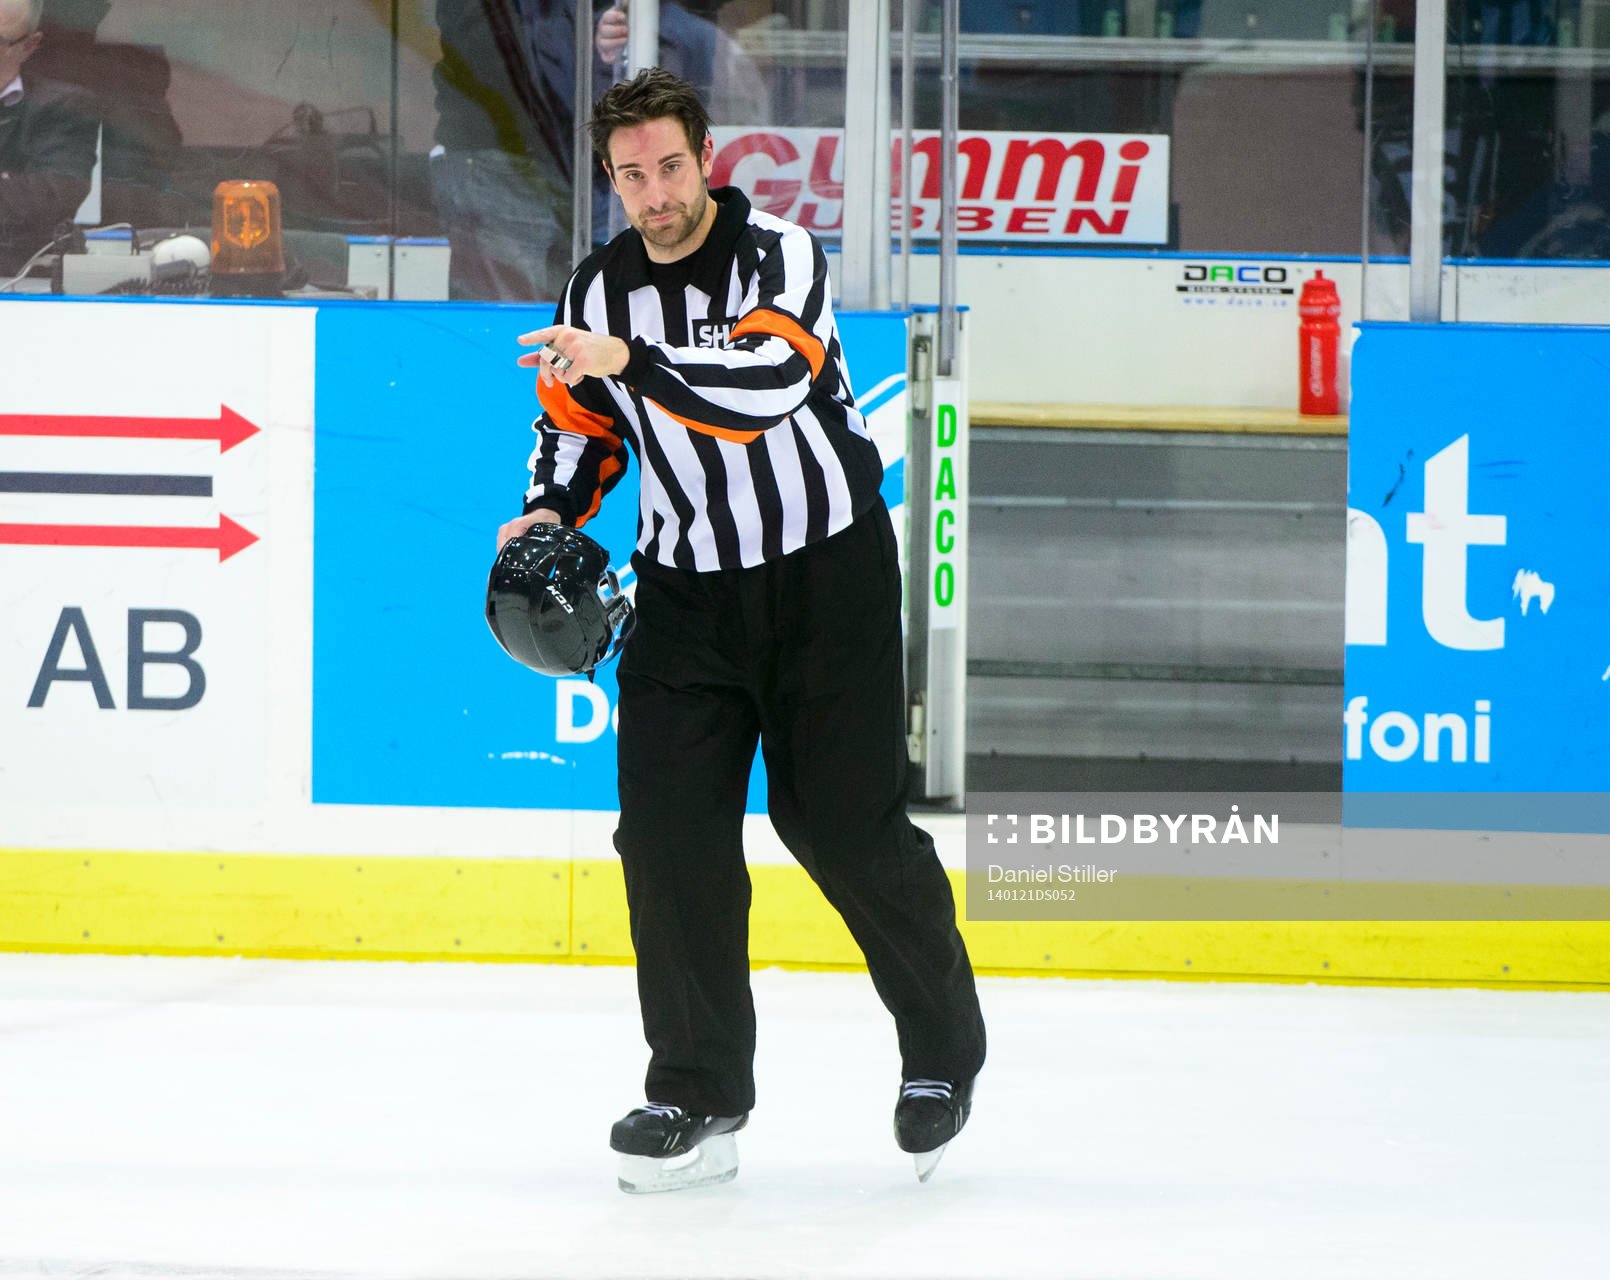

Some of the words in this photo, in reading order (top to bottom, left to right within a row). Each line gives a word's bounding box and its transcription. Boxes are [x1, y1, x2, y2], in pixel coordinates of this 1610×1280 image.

[1184, 265, 1287, 283] DACO
[699, 322, 737, 349] SH
[934, 404, 957, 607] DACO
[545, 584, 574, 615] CCM
[26, 606, 207, 711] AB
[556, 679, 619, 743] D
